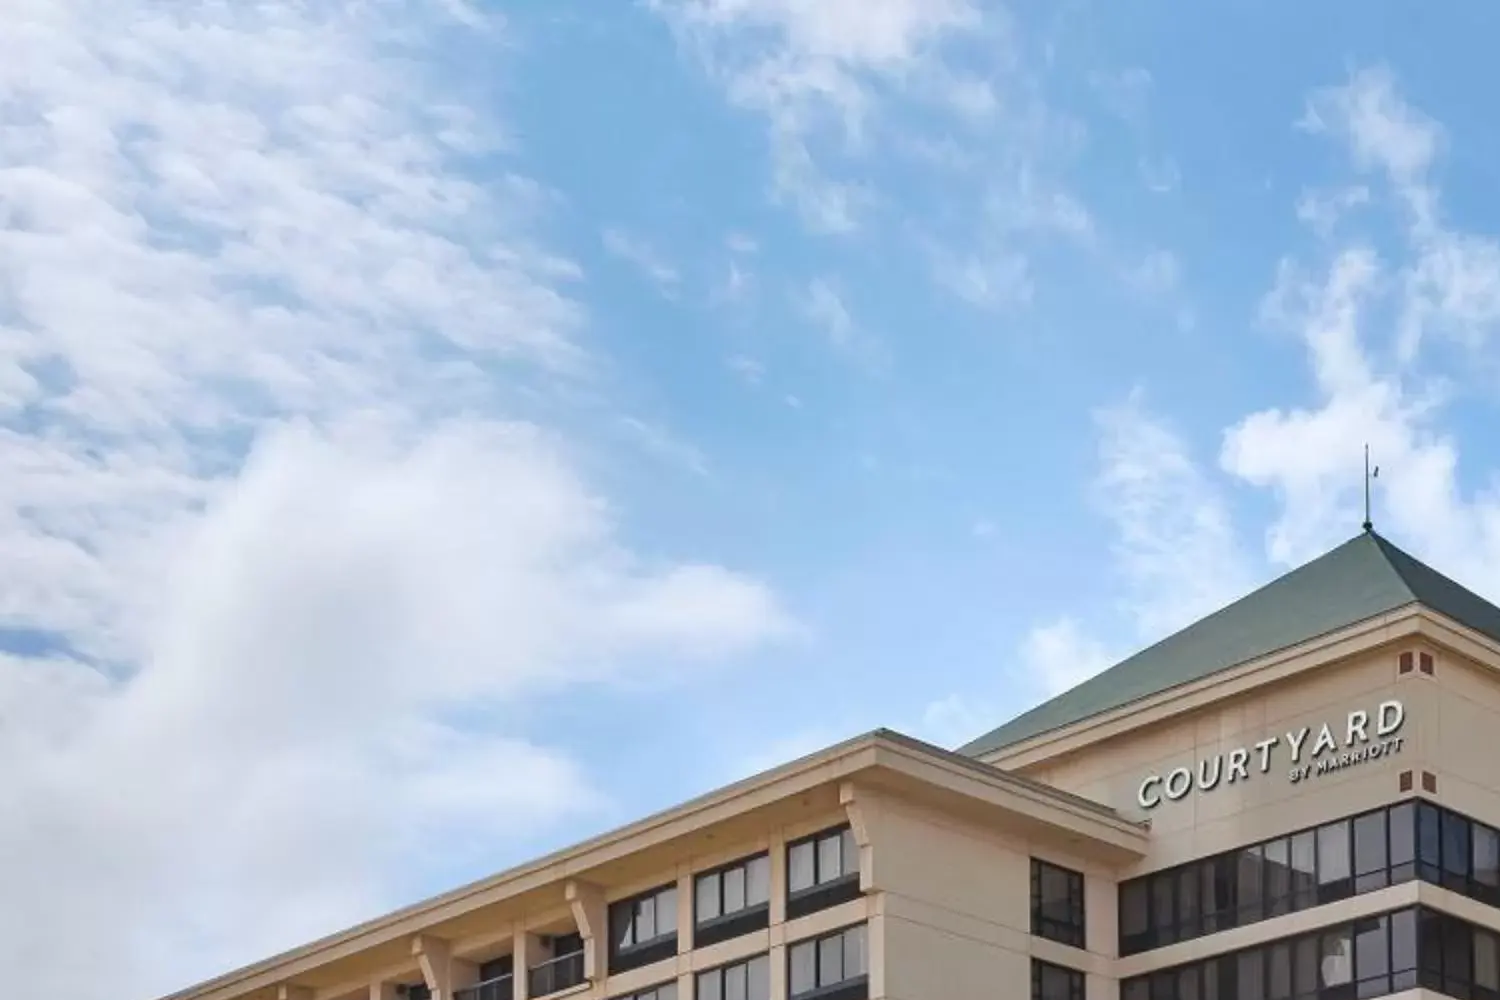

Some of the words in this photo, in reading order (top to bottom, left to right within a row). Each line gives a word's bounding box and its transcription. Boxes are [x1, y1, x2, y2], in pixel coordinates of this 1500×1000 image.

[1137, 699, 1406, 810] COURTYARD
[1289, 764, 1312, 783] BY
[1316, 737, 1405, 775] MARRIOTT
